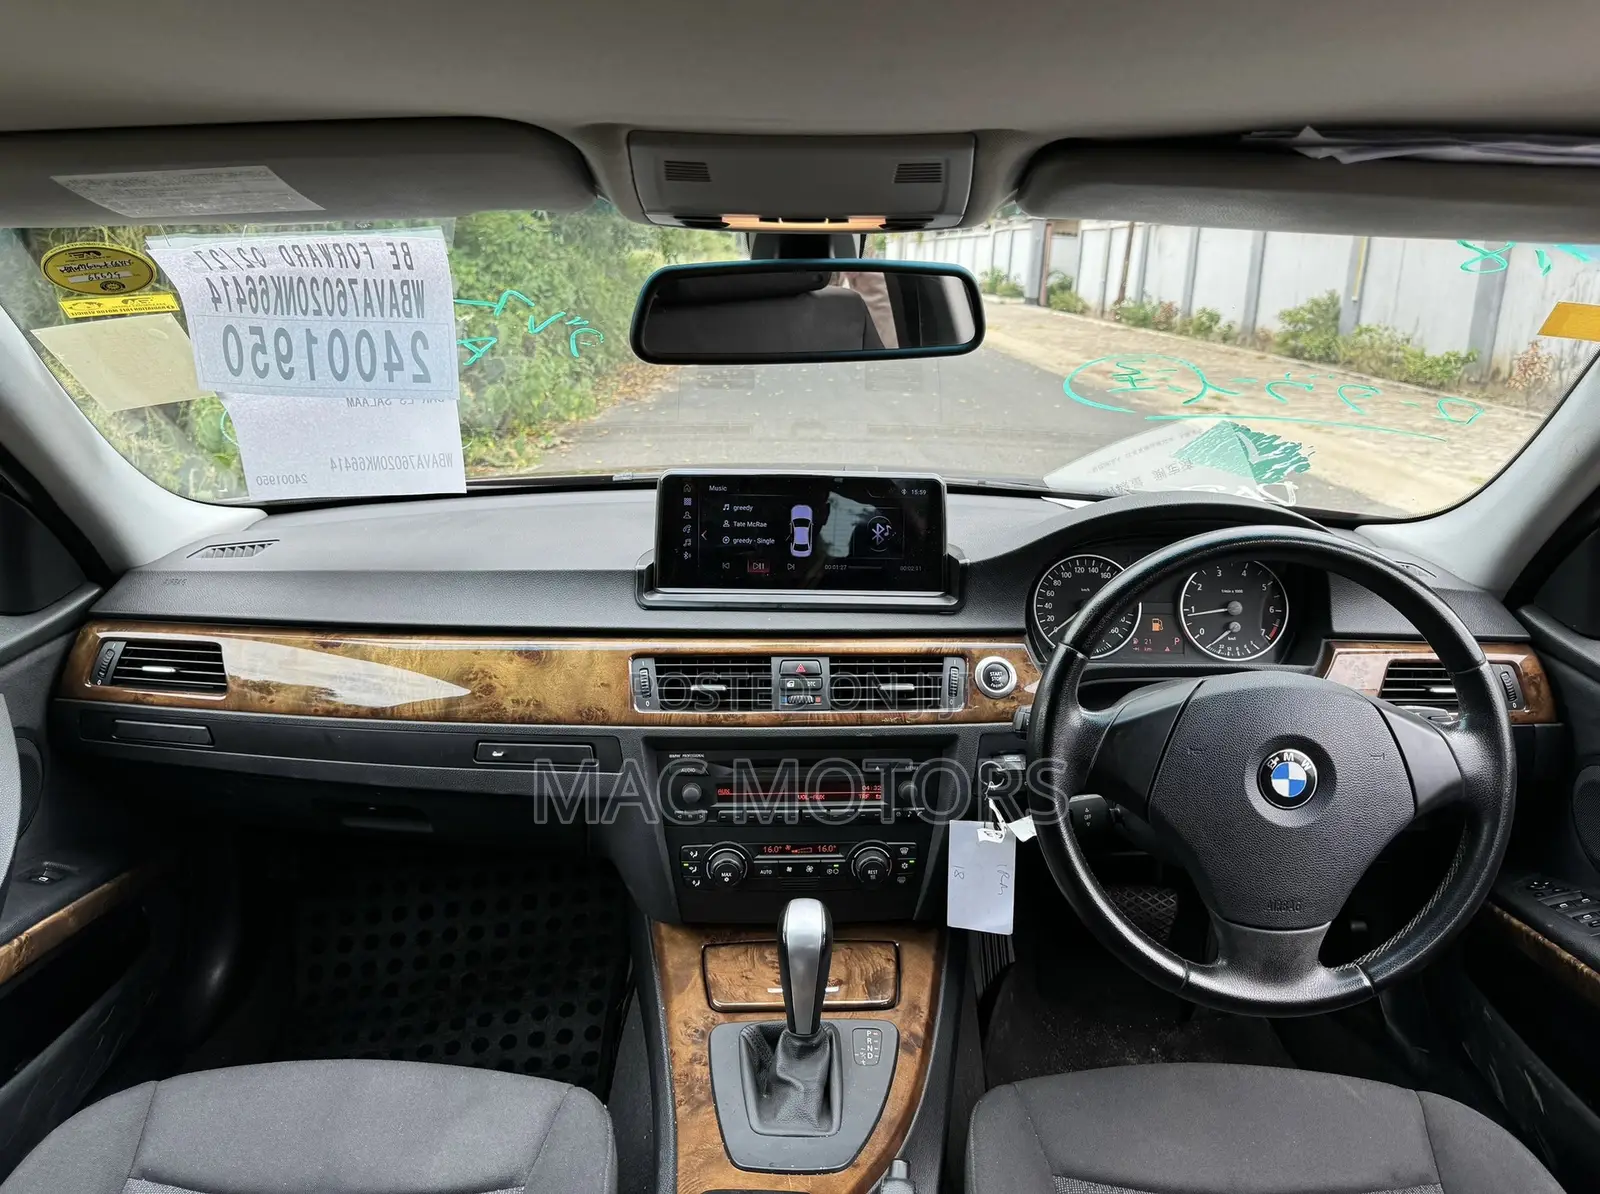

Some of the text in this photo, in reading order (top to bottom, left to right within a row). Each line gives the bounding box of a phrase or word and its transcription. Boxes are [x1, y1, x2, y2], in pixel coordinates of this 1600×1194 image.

[709, 484, 728, 492] Music
[911, 488, 927, 496] 15:59
[733, 505, 753, 513] greedy
[733, 520, 768, 529] Tate McRae
[733, 538, 754, 546] greedy
[757, 537, 775, 546] Single
[1088, 566, 1099, 574] 140
[1217, 569, 1222, 577] 3
[1241, 569, 1247, 577] 4
[1052, 579, 1062, 587] 80
[1197, 583, 1203, 591] 2
[1262, 583, 1267, 591] 5
[1260, 628, 1266, 636] 7
[1174, 637, 1180, 645] P
